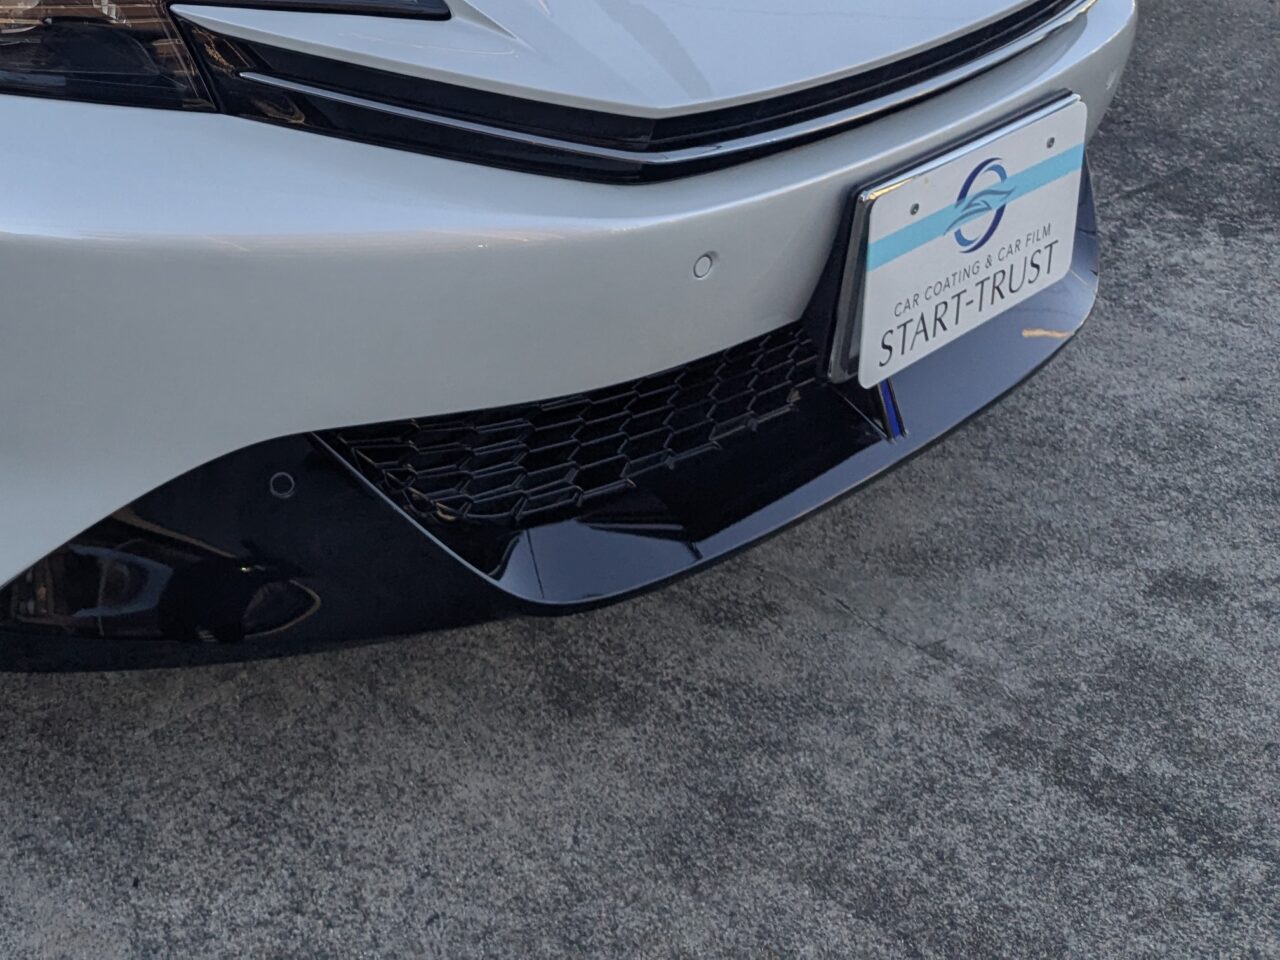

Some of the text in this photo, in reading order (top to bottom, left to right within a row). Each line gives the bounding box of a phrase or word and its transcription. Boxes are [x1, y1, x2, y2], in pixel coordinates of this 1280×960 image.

[878, 239, 1059, 367] START-TRUST
[894, 223, 1052, 318] CAR COATING & CAR FILM
